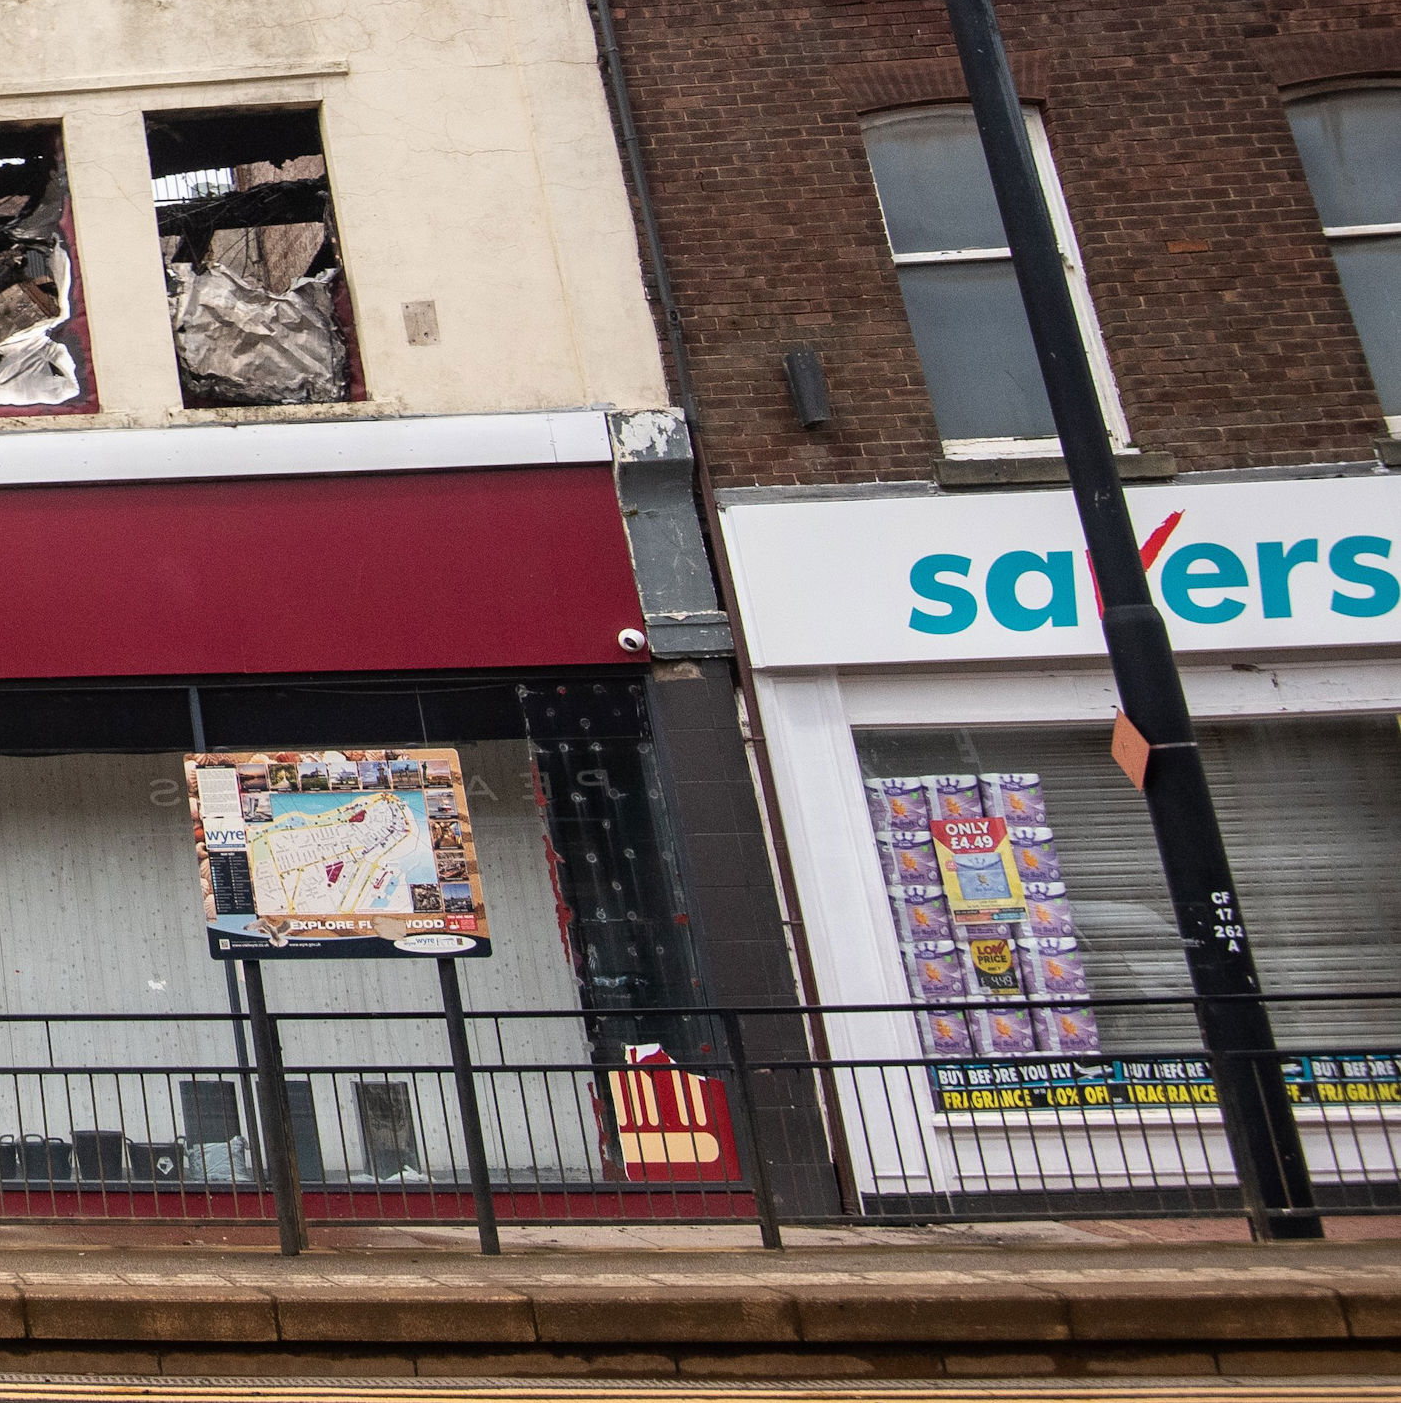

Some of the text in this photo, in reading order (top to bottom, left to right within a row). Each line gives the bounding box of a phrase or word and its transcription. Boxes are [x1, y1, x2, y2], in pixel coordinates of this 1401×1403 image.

[945, 821, 990, 836] ONLY
[206, 830, 244, 844] wyre
[950, 835, 993, 850] £4.49
[1211, 892, 1230, 904] CF
[1215, 908, 1233, 920] 17
[290, 920, 355, 930] EXPLORE
[1214, 925, 1243, 937] 262
[976, 942, 1006, 955] LOW
[1228, 940, 1240, 952] A
[977, 955, 1007, 965] PRICE
[938, 1069, 965, 1085] BUY
[1018, 1064, 1047, 1081] YOU
[1049, 1062, 1071, 1079] FLY
